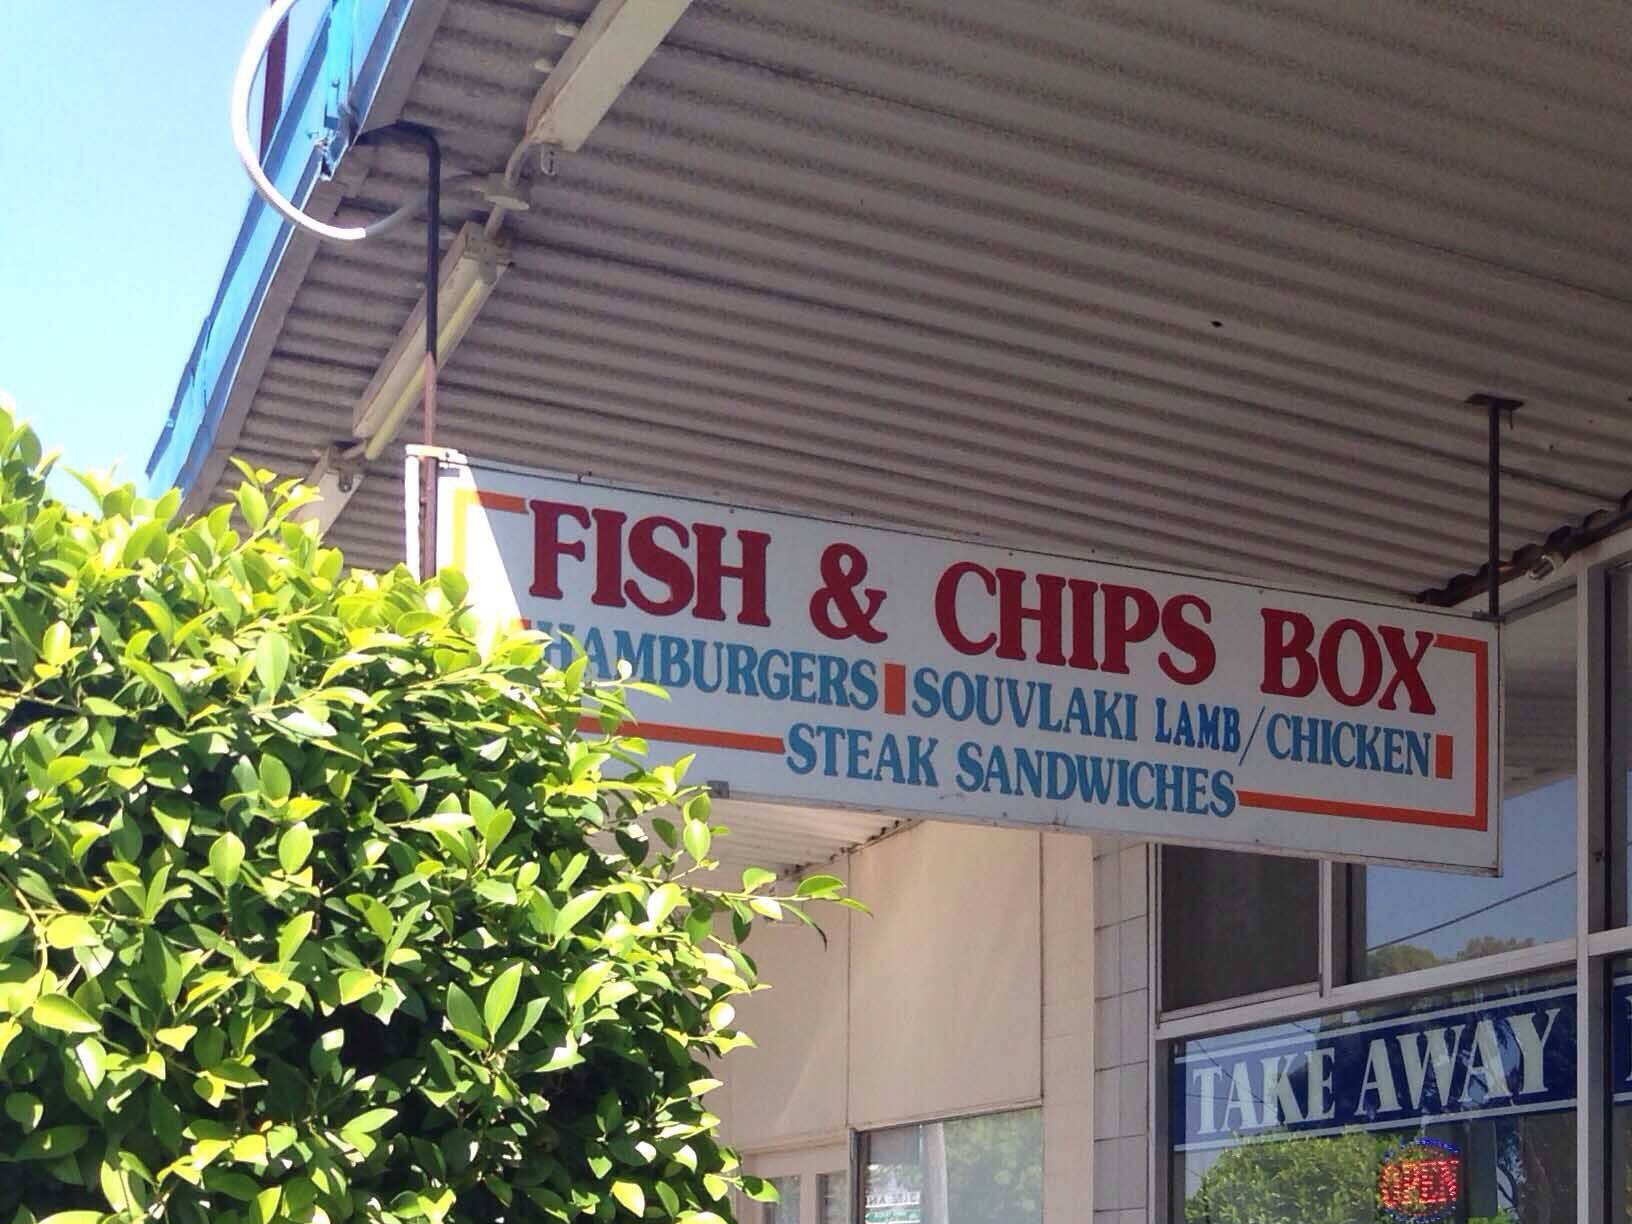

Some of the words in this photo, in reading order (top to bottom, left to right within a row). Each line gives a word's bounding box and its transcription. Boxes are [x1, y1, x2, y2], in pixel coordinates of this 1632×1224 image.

[529, 500, 771, 626] FISH
[810, 543, 888, 642] &
[935, 561, 1216, 685] CHIPS
[1261, 608, 1436, 714] BOX
[537, 621, 879, 710] HAMBURGERS
[912, 666, 1138, 742] SOUVLAKI
[785, 723, 938, 787] STEAK
[956, 741, 1236, 817] SANDWICHES
[1192, 1047, 1335, 1135] TAKE
[1354, 1007, 1562, 1117] AWAY
